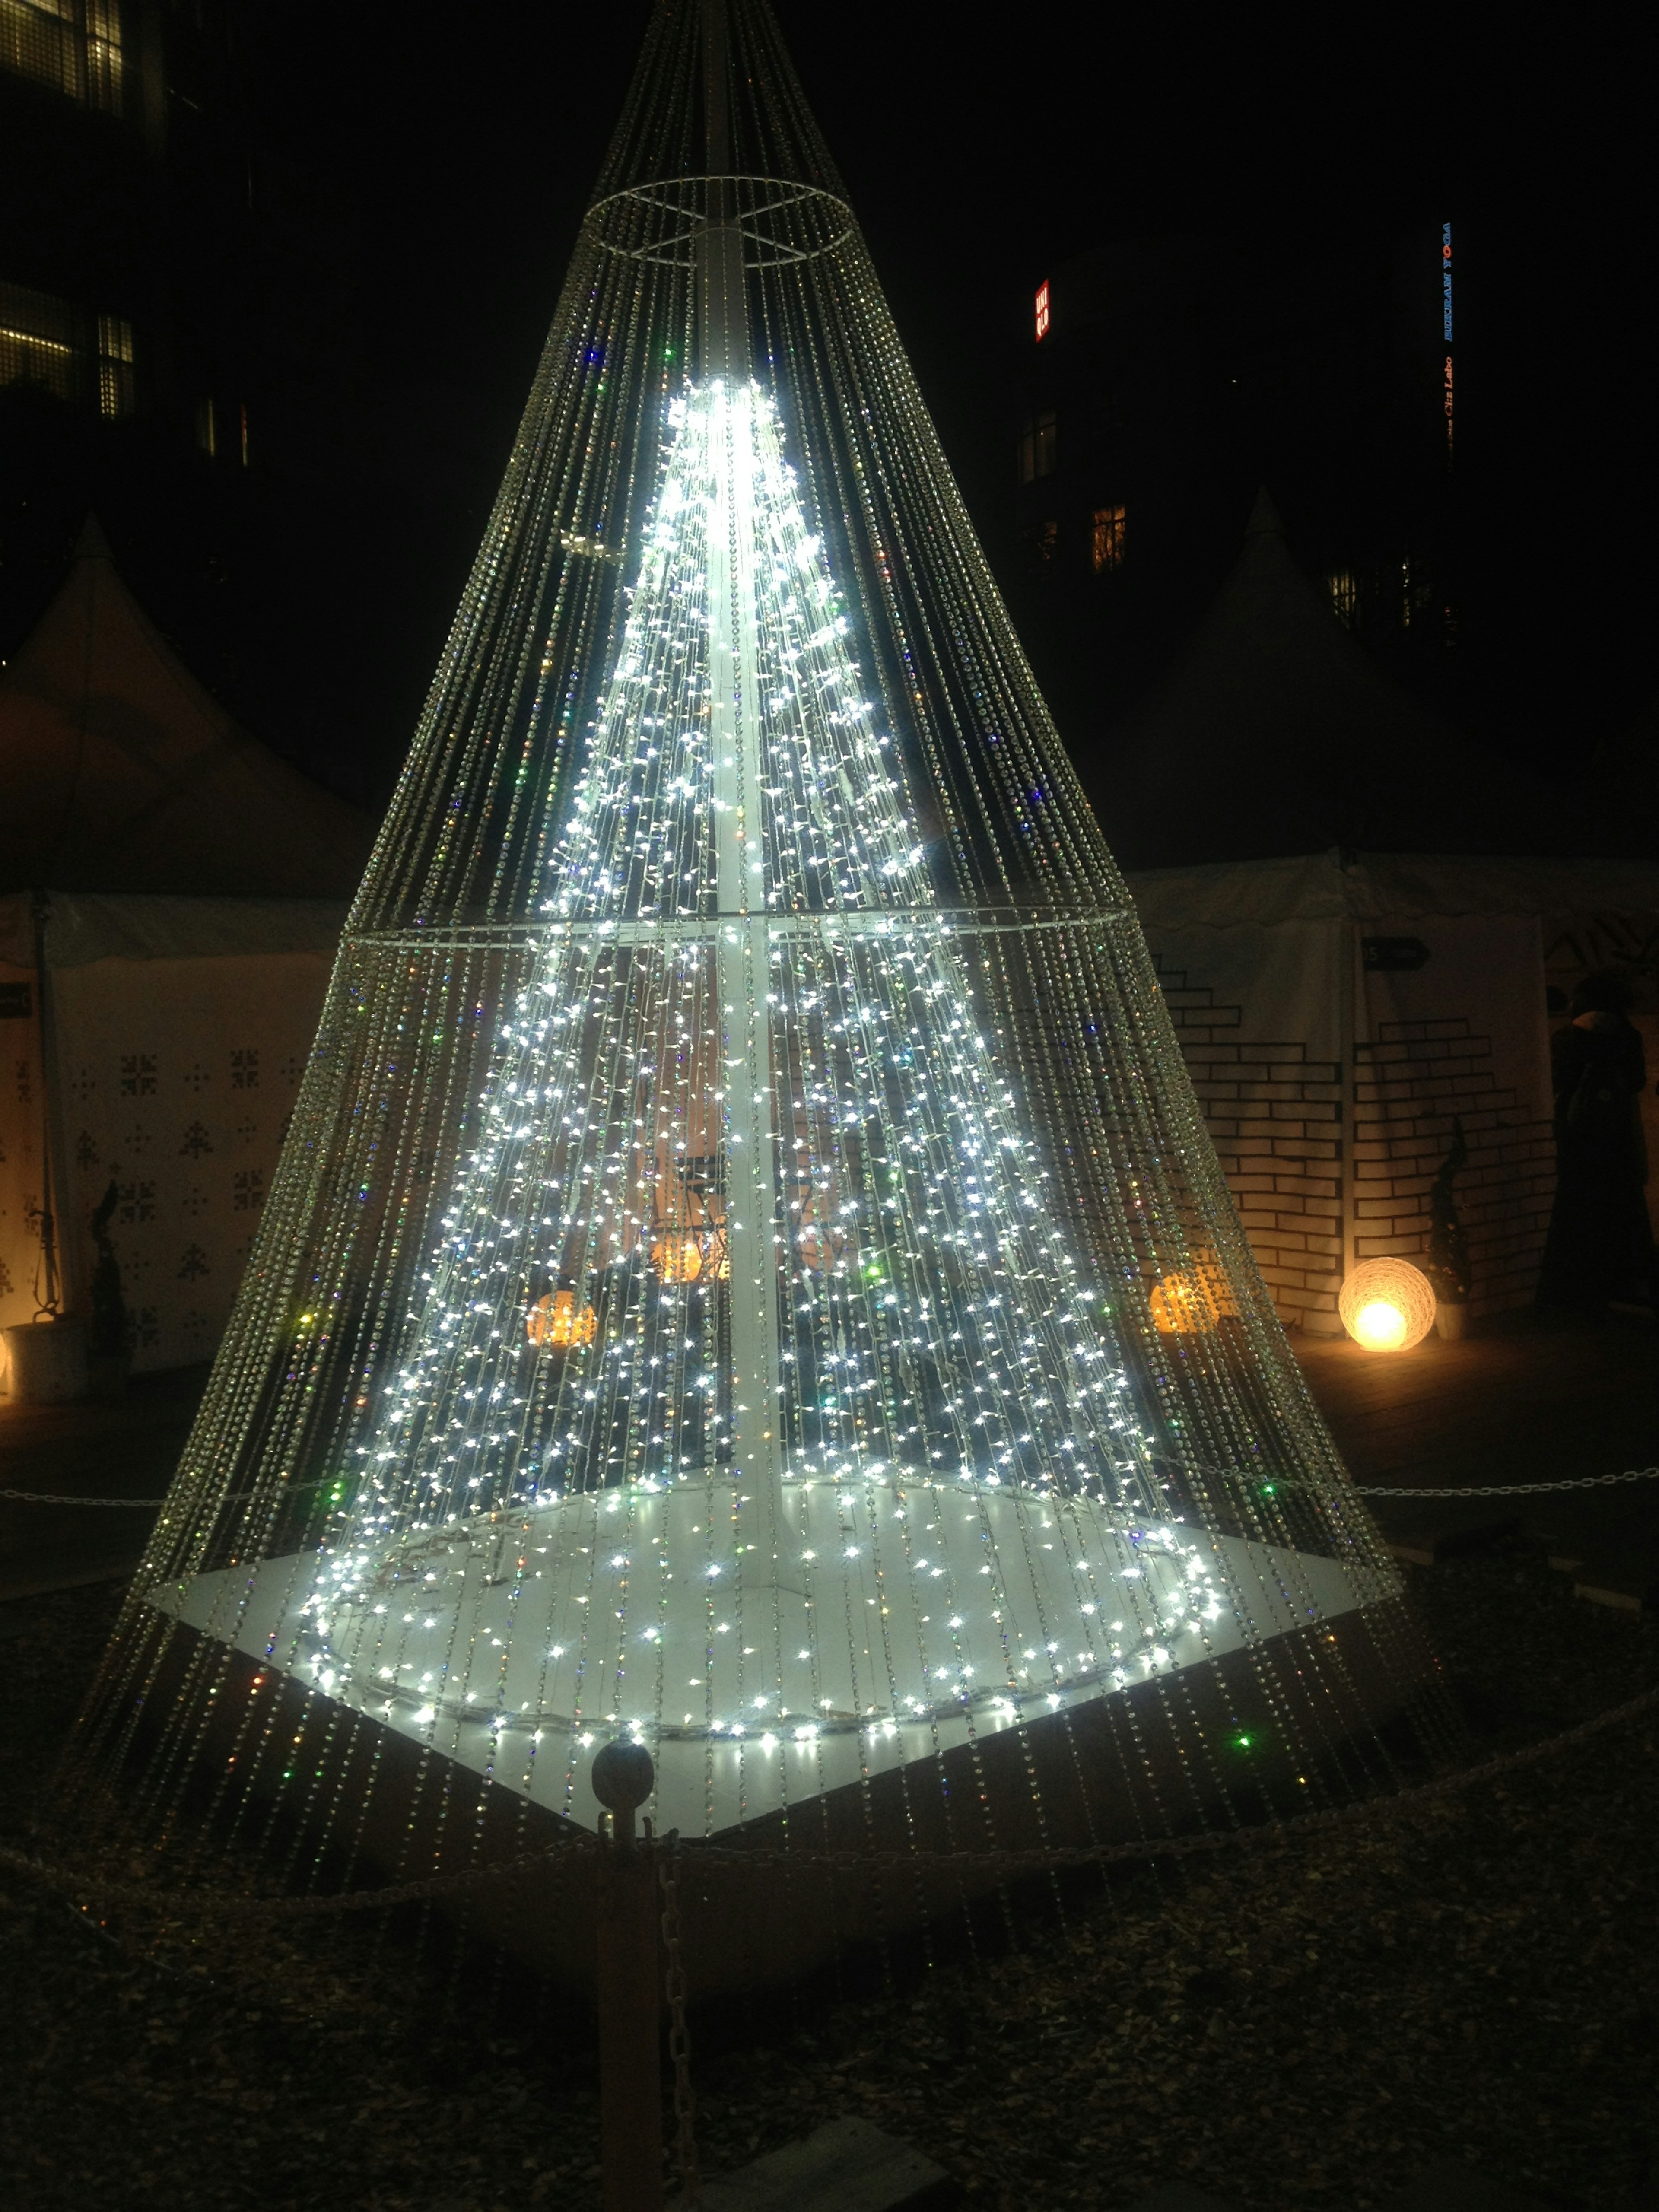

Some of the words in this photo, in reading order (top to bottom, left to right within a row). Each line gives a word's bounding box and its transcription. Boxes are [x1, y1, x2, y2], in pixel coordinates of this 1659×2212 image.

[1442, 222, 1452, 269] YOGA
[1036, 287, 1047, 314] UNI
[1443, 272, 1453, 342] BIKRAM
[1037, 308, 1049, 337] QLO
[1443, 356, 1453, 390] Labo
